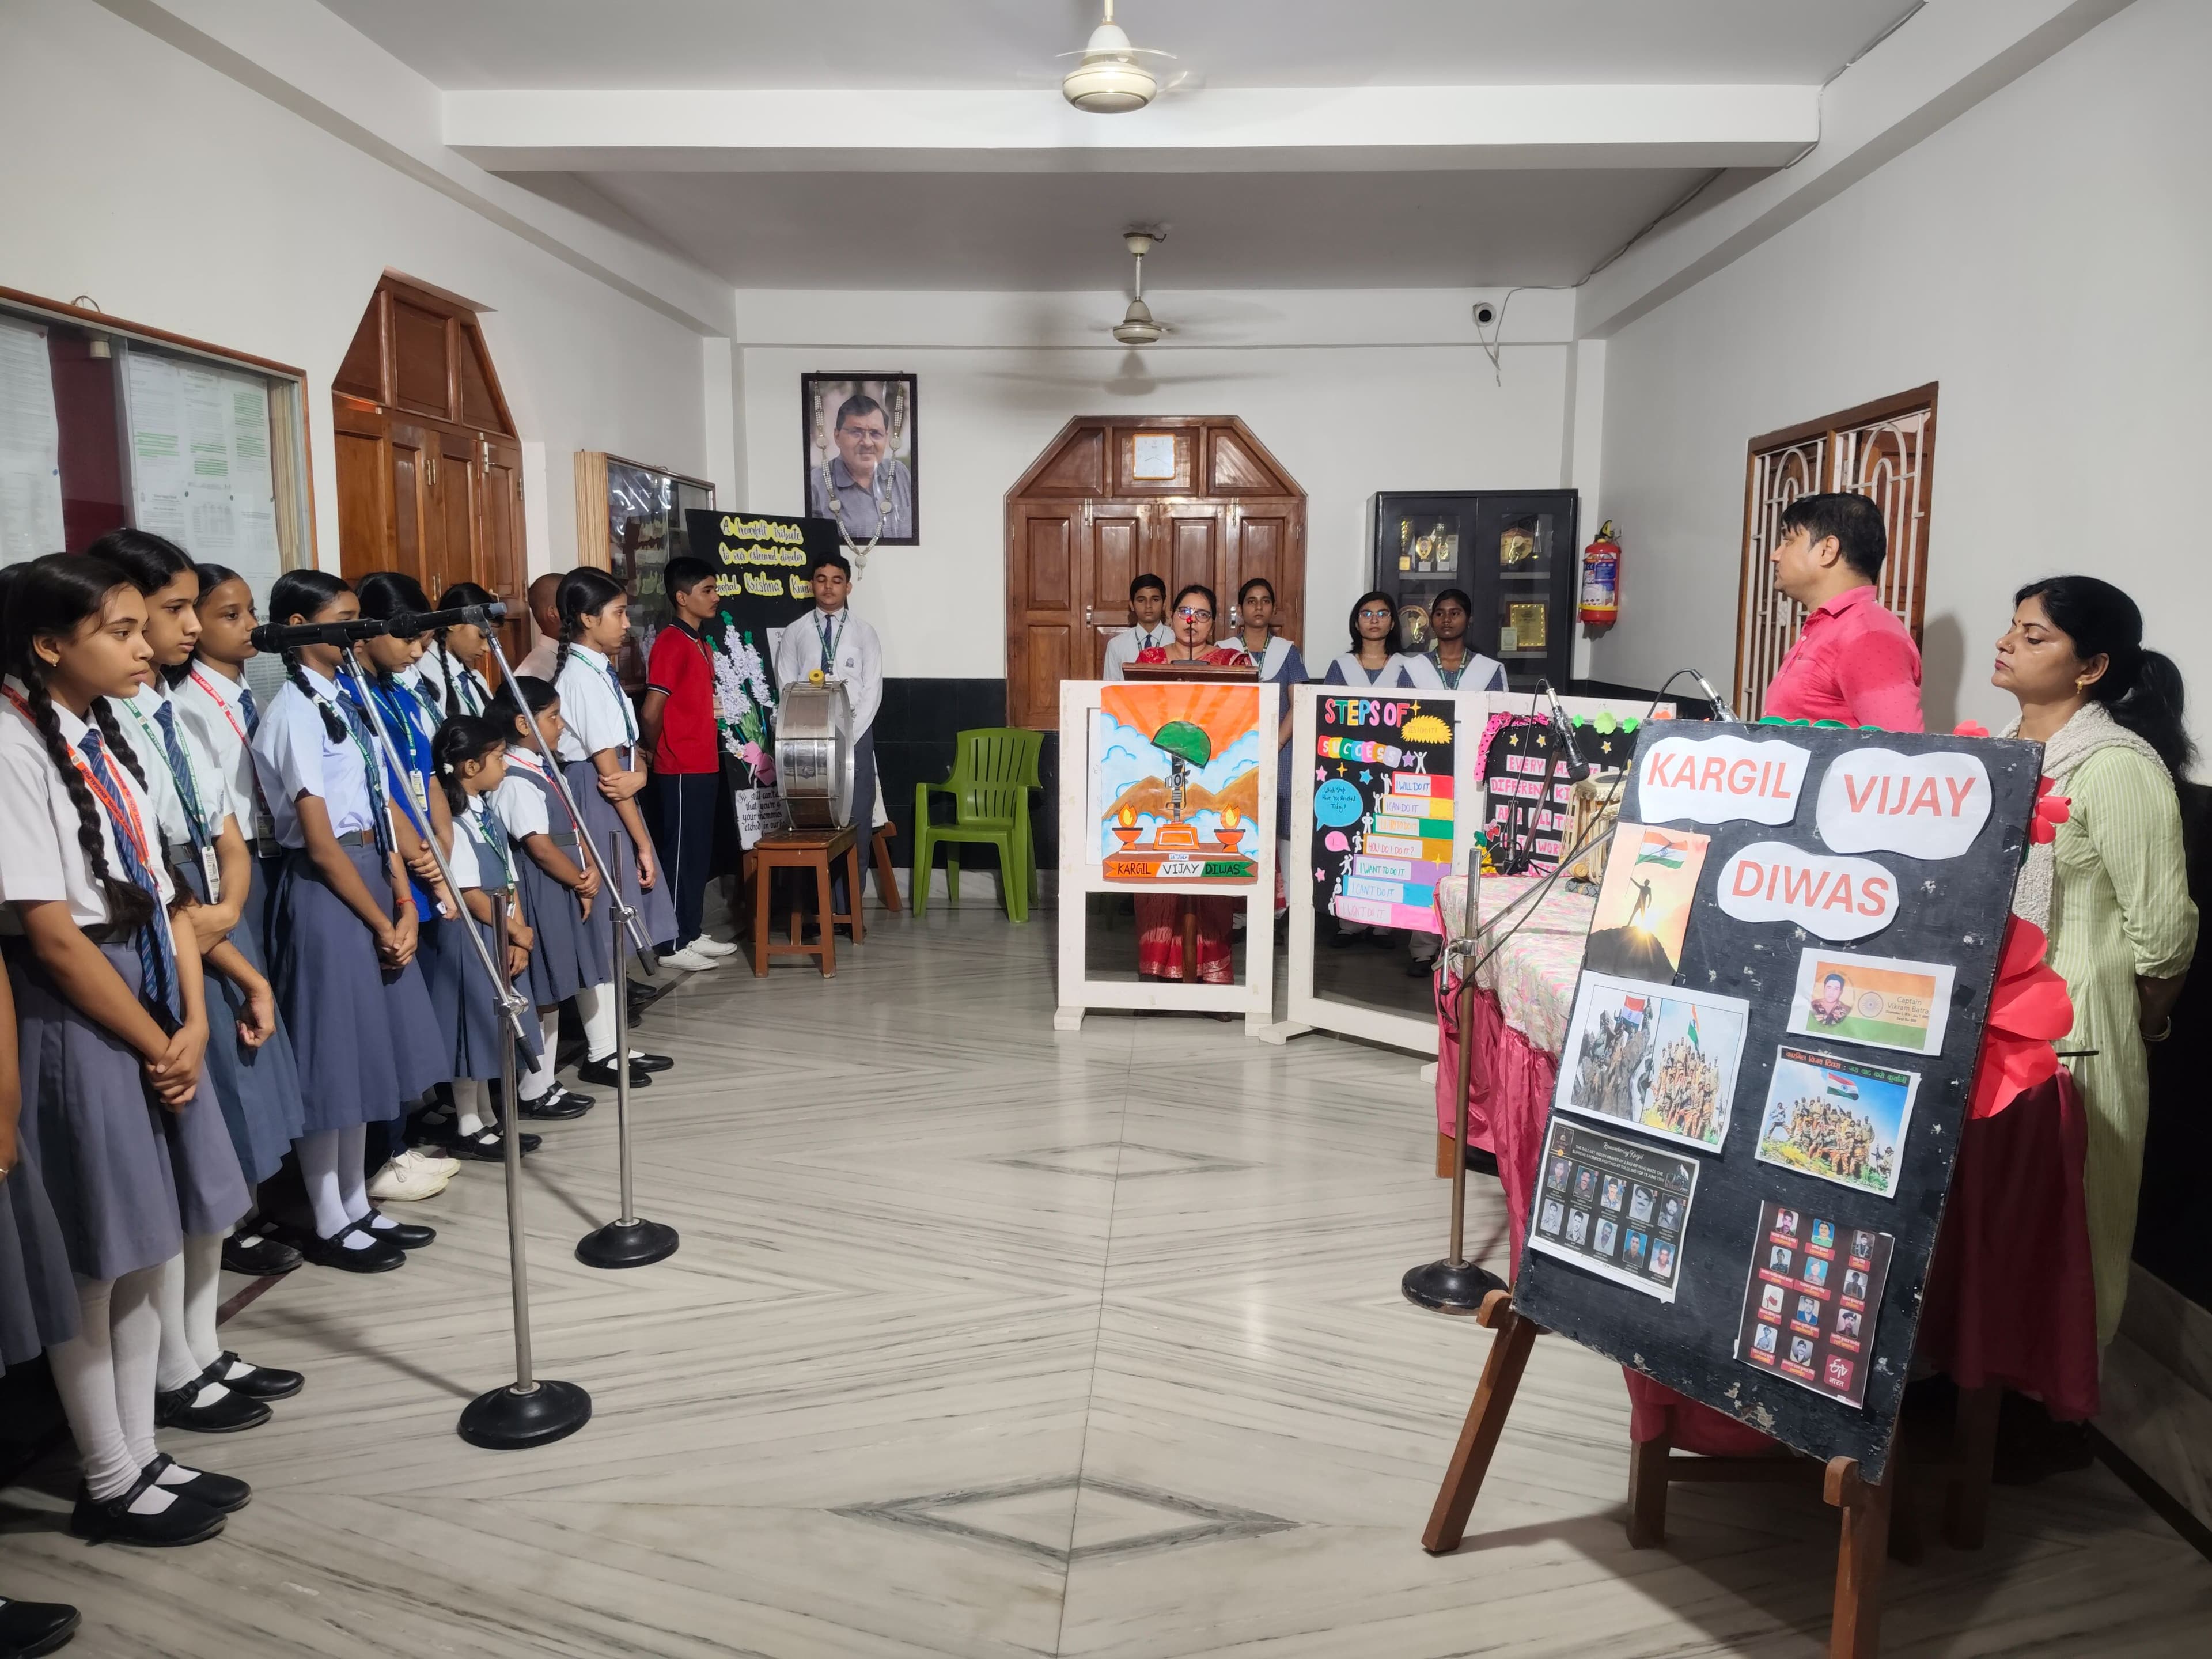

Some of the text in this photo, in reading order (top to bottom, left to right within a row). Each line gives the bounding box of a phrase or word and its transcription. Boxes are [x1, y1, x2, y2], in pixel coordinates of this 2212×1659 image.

[723, 519, 730, 533] A
[773, 526, 801, 540] tribute
[722, 547, 729, 560] to
[780, 550, 803, 562] director
[746, 575, 780, 592] Krishna
[1325, 698, 1410, 728] STEPS OF
[146, 727, 166, 757] BHAGALPUR
[1321, 738, 1398, 763] SUCCESS
[1508, 756, 1544, 774] EVERY
[1399, 782, 1412, 791] WILL
[1413, 783, 1422, 791] DO
[1422, 783, 1430, 791] IT
[1491, 778, 1544, 797] DIFFEREN
[1646, 752, 1976, 817] KARGIL VIJAY
[745, 802, 757, 810] that
[1388, 800, 1400, 809] CAN
[1402, 802, 1411, 811] DO
[1411, 804, 1419, 812] IT
[742, 813, 757, 825] your
[1368, 842, 1380, 852] HOW
[1382, 844, 1388, 853] DO
[1395, 846, 1402, 854] DO
[1118, 862, 1241, 875] KARGIL VIJAY DIWAS
[1363, 862, 1381, 874] WANT
[1382, 866, 1389, 874] TO
[1389, 868, 1397, 876] DO
[1398, 868, 1405, 876] IT
[1376, 887, 1385, 896] DO
[1387, 888, 1395, 897] IT
[1732, 859, 1890, 918] DIWAS
[1887, 1002, 1910, 1012] Vikram
[1911, 1005, 1930, 1014] Batra
[1897, 996, 1922, 1007] Captain
[1828, 1376, 1844, 1387] भारत
